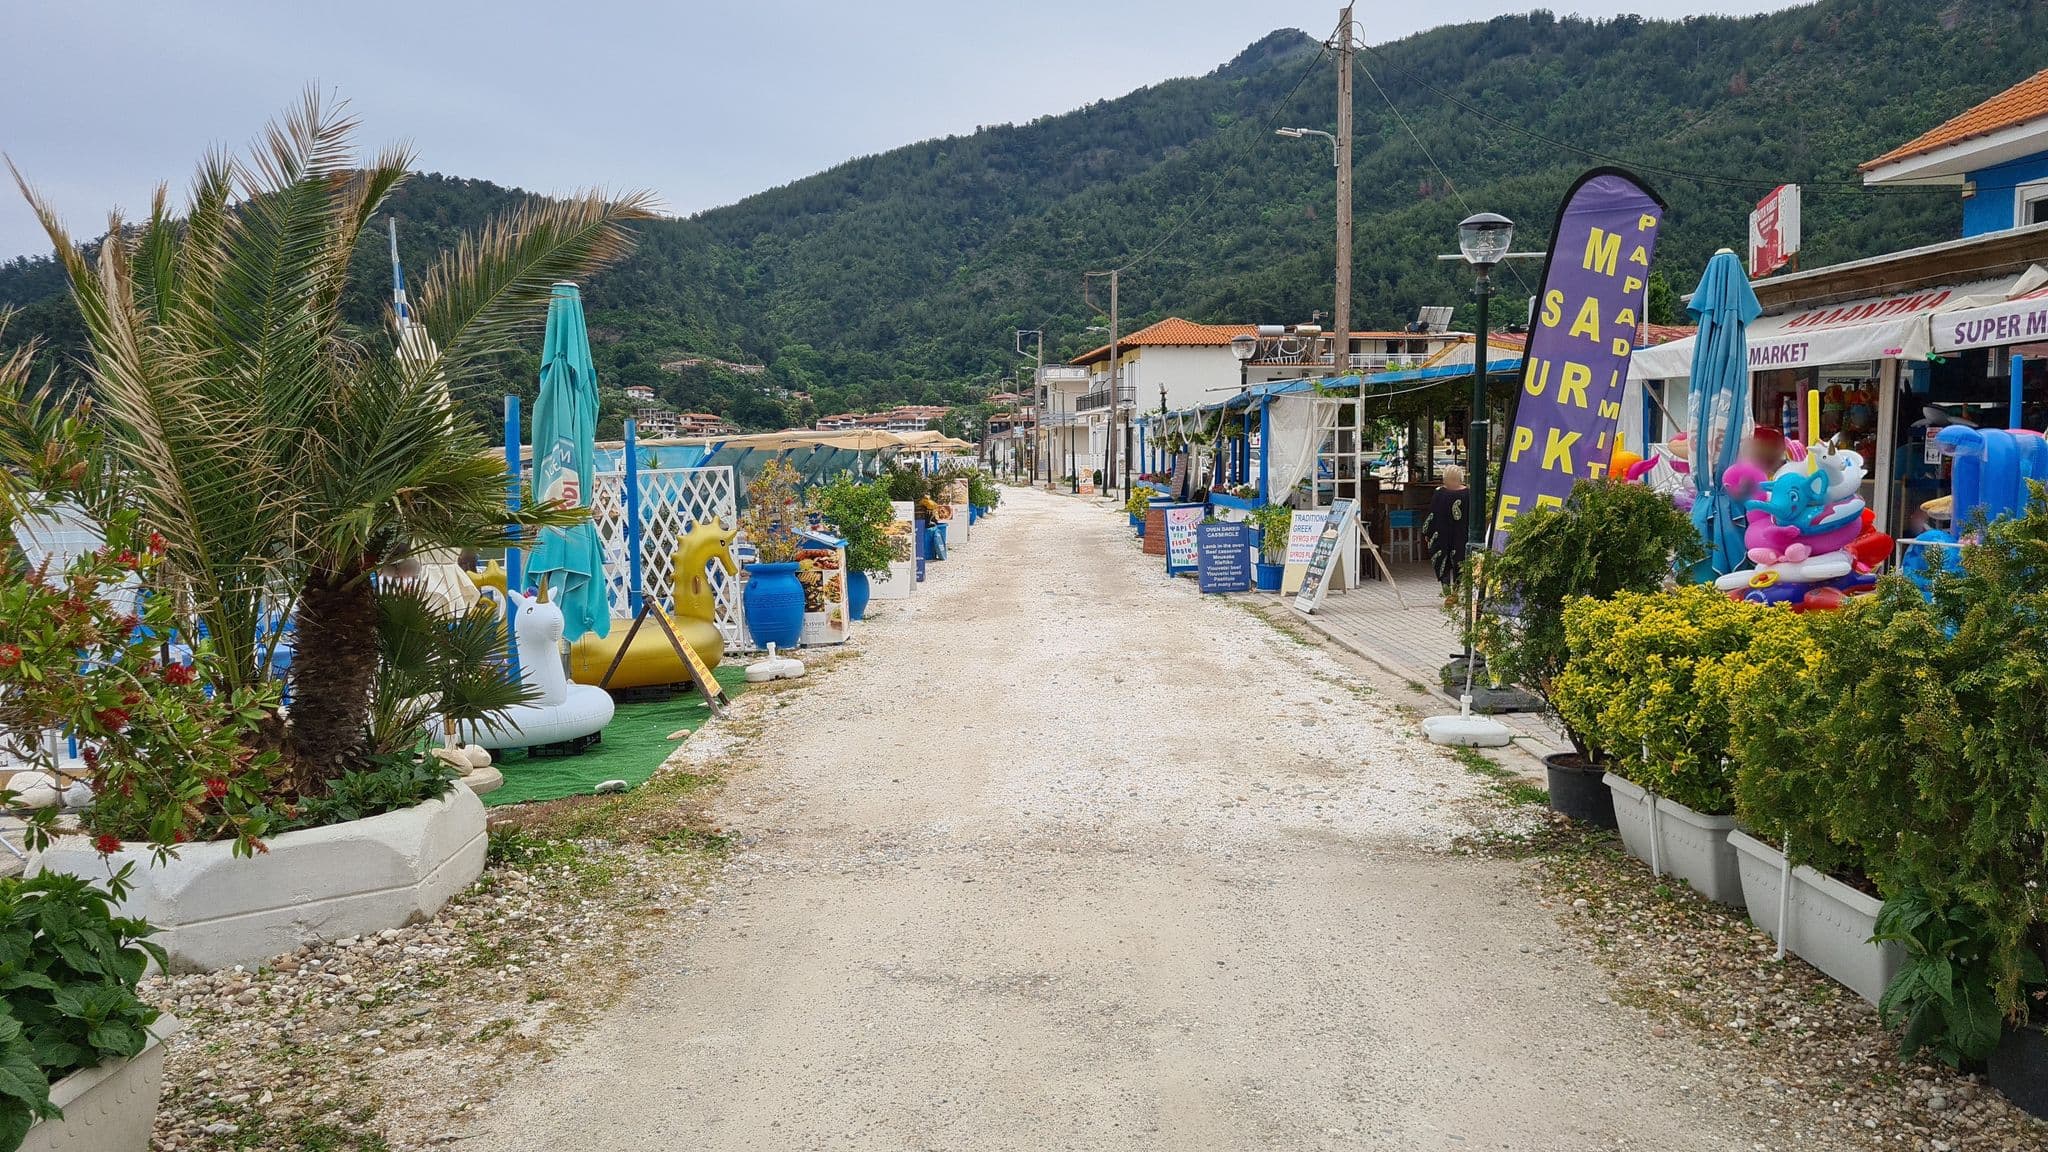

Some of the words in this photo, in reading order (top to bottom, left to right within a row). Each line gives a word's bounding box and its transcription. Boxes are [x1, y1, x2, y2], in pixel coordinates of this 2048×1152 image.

[1954, 314, 2021, 345] SUPER
[1587, 213, 1657, 480] PAPADIMIT
[1748, 342, 1809, 366] MARKET
[1496, 289, 1564, 531] SUPE
[1293, 524, 1313, 532] GREEK
